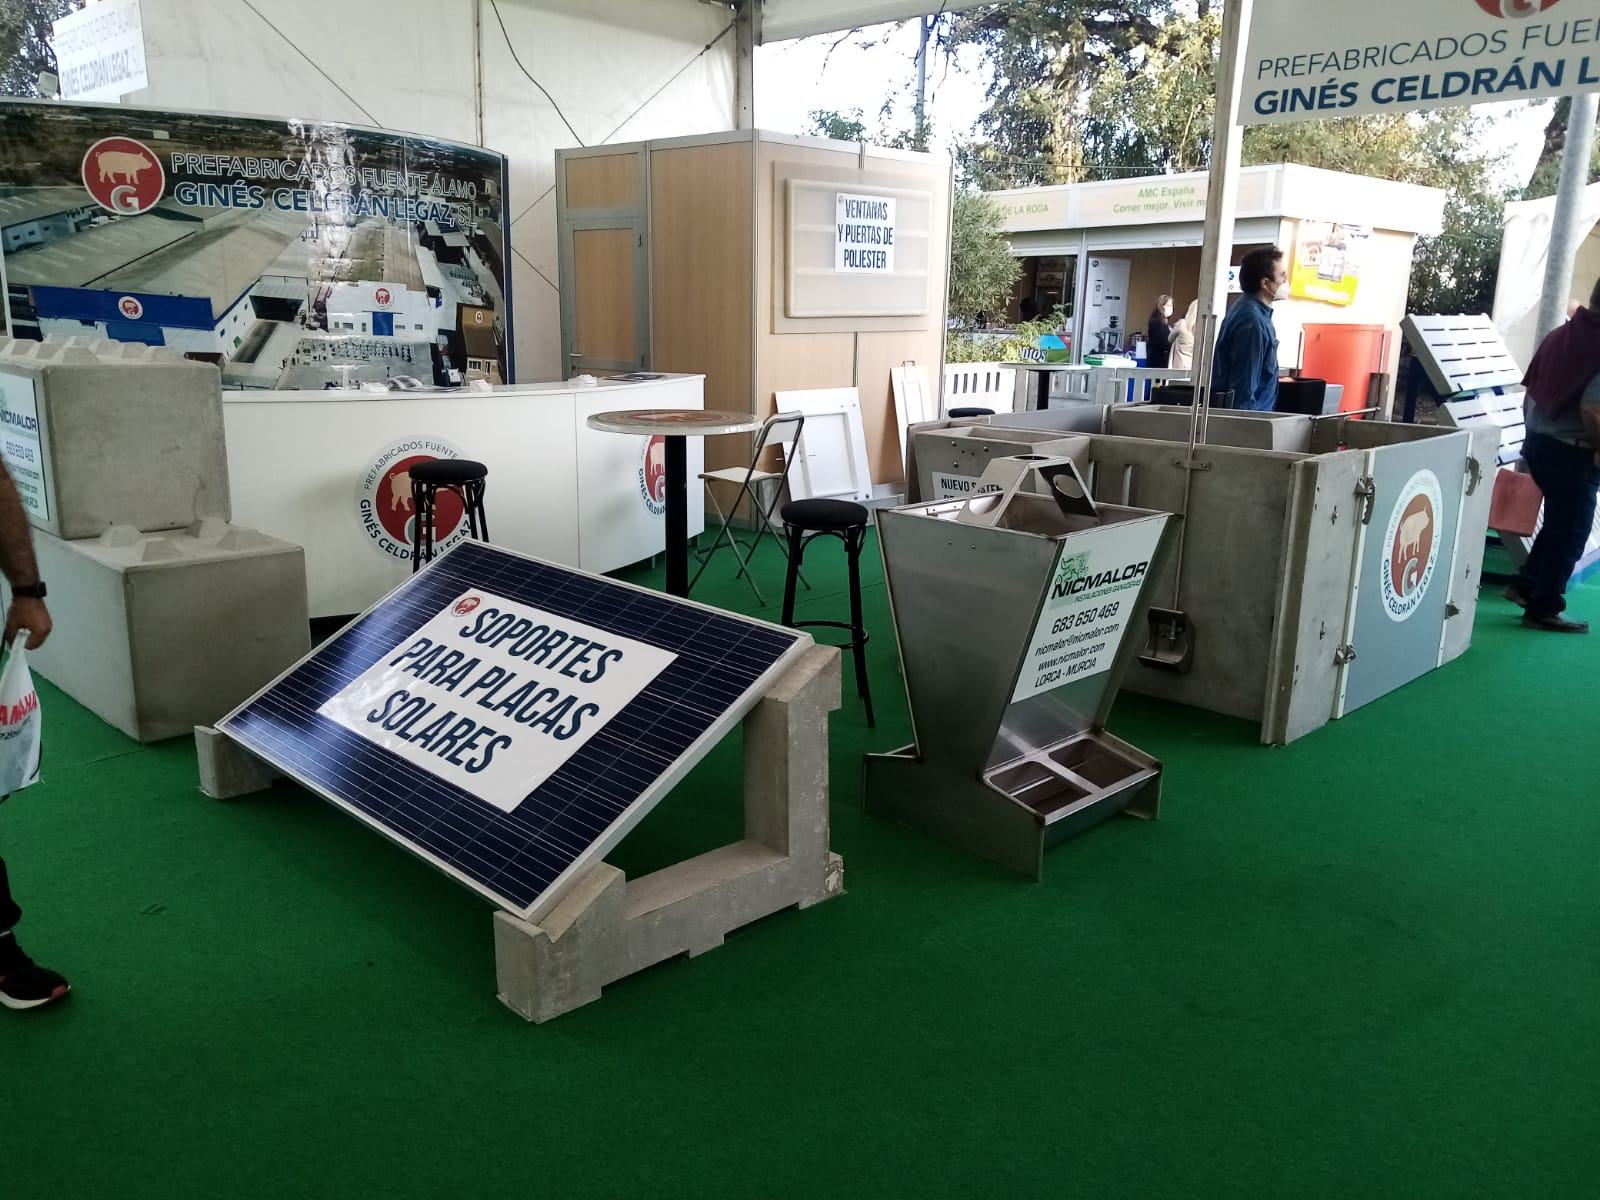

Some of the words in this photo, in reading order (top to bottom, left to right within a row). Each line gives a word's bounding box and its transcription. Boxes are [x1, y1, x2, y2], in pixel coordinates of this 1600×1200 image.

[1257, 29, 1507, 80] PREFABRICADOS
[1521, 18, 1600, 50] FUE
[1253, 78, 1359, 116] GINÉS
[1370, 56, 1566, 103] CELDRÁN
[171, 152, 356, 186] PREFABRICADOS
[362, 167, 429, 195] FUENTE
[430, 172, 477, 201] ÁLAMO
[1138, 187, 1158, 198] AMC
[1161, 185, 1195, 198] España
[174, 180, 266, 210] GINÉS
[272, 188, 389, 219] CELDRÁN
[845, 199, 888, 221] VENTANAS
[1014, 205, 1025, 215] LA
[1026, 203, 1049, 214] RODA
[1113, 202, 1142, 214] Comer
[1173, 199, 1195, 209] Vivir
[837, 223, 844, 243] Y
[845, 224, 882, 245] PUERTAS
[883, 227, 894, 245] DE
[843, 248, 887, 269] POLIESTER
[364, 441, 423, 490] PREFABRICADOS
[425, 441, 459, 461] FUENTE
[940, 478, 970, 492] NUEVO
[360, 499, 382, 539] GINÉS
[1051, 561, 1149, 600] NICMALOR
[1051, 614, 1075, 635] 683
[1075, 607, 1098, 628] 650
[1098, 601, 1120, 621] 469
[459, 608, 623, 684] SOPORTES
[1034, 623, 1120, 657] nicmalor@nicmalor.com
[1038, 642, 1106, 672] www.nicmalor.com
[389, 637, 481, 693] PARA
[461, 665, 600, 741] PLACAS
[1034, 668, 1062, 688] LORCA
[1065, 657, 1097, 678] MURCIA
[366, 689, 512, 774] SOLARES
